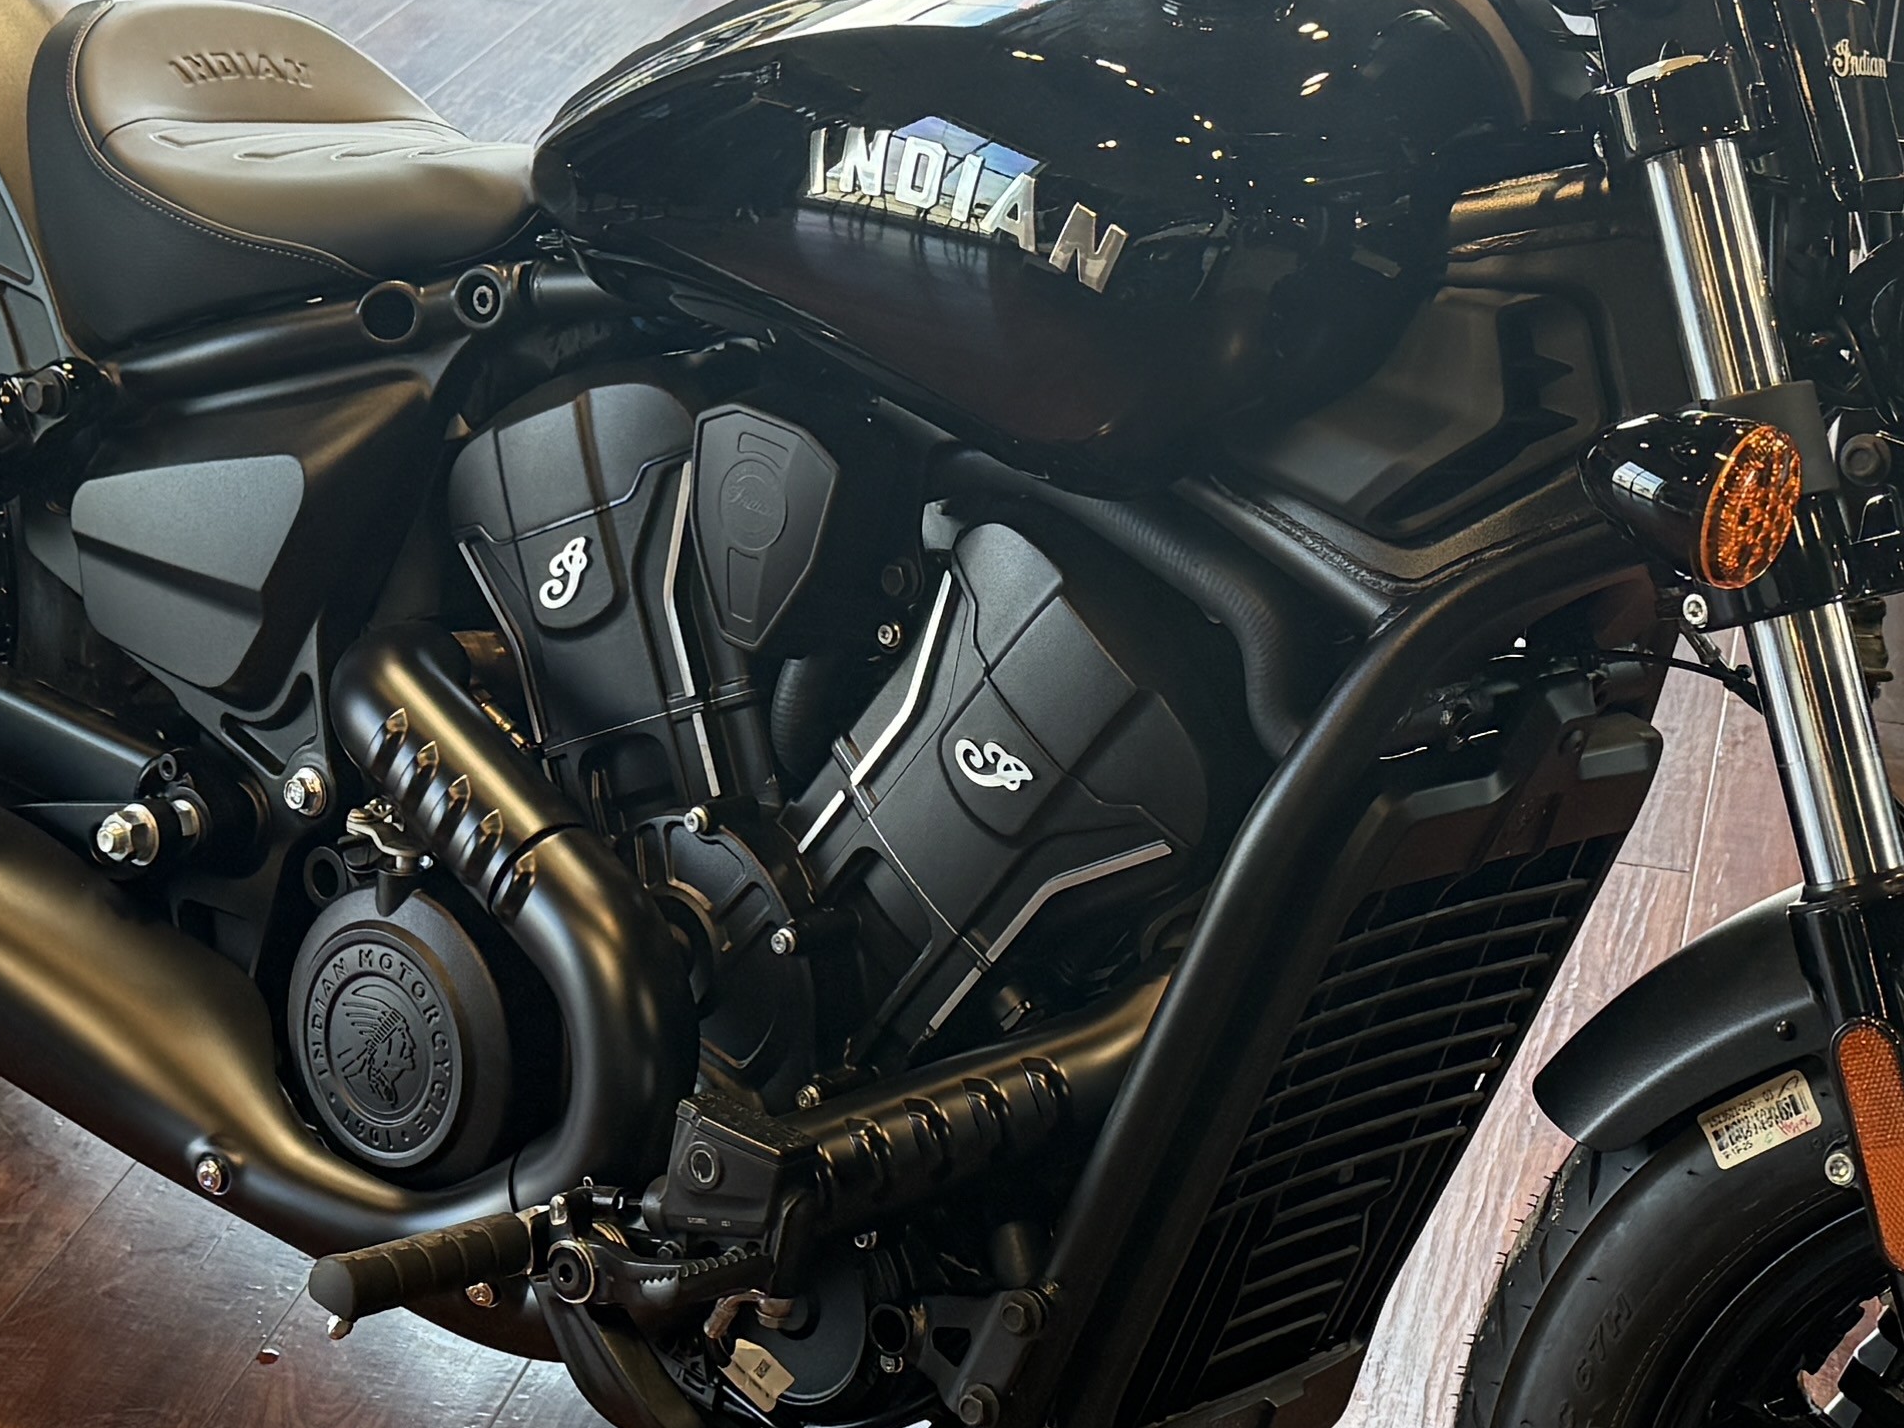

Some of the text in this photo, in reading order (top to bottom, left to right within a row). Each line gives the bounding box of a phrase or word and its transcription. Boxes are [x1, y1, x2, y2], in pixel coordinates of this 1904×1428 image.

[168, 52, 314, 89] INDIAN
[1832, 38, 1888, 78] Indian
[807, 126, 1128, 293] INDIAN
[311, 948, 450, 1135] INDIAN MOTORCYCLE
[344, 1112, 394, 1149] 1901
